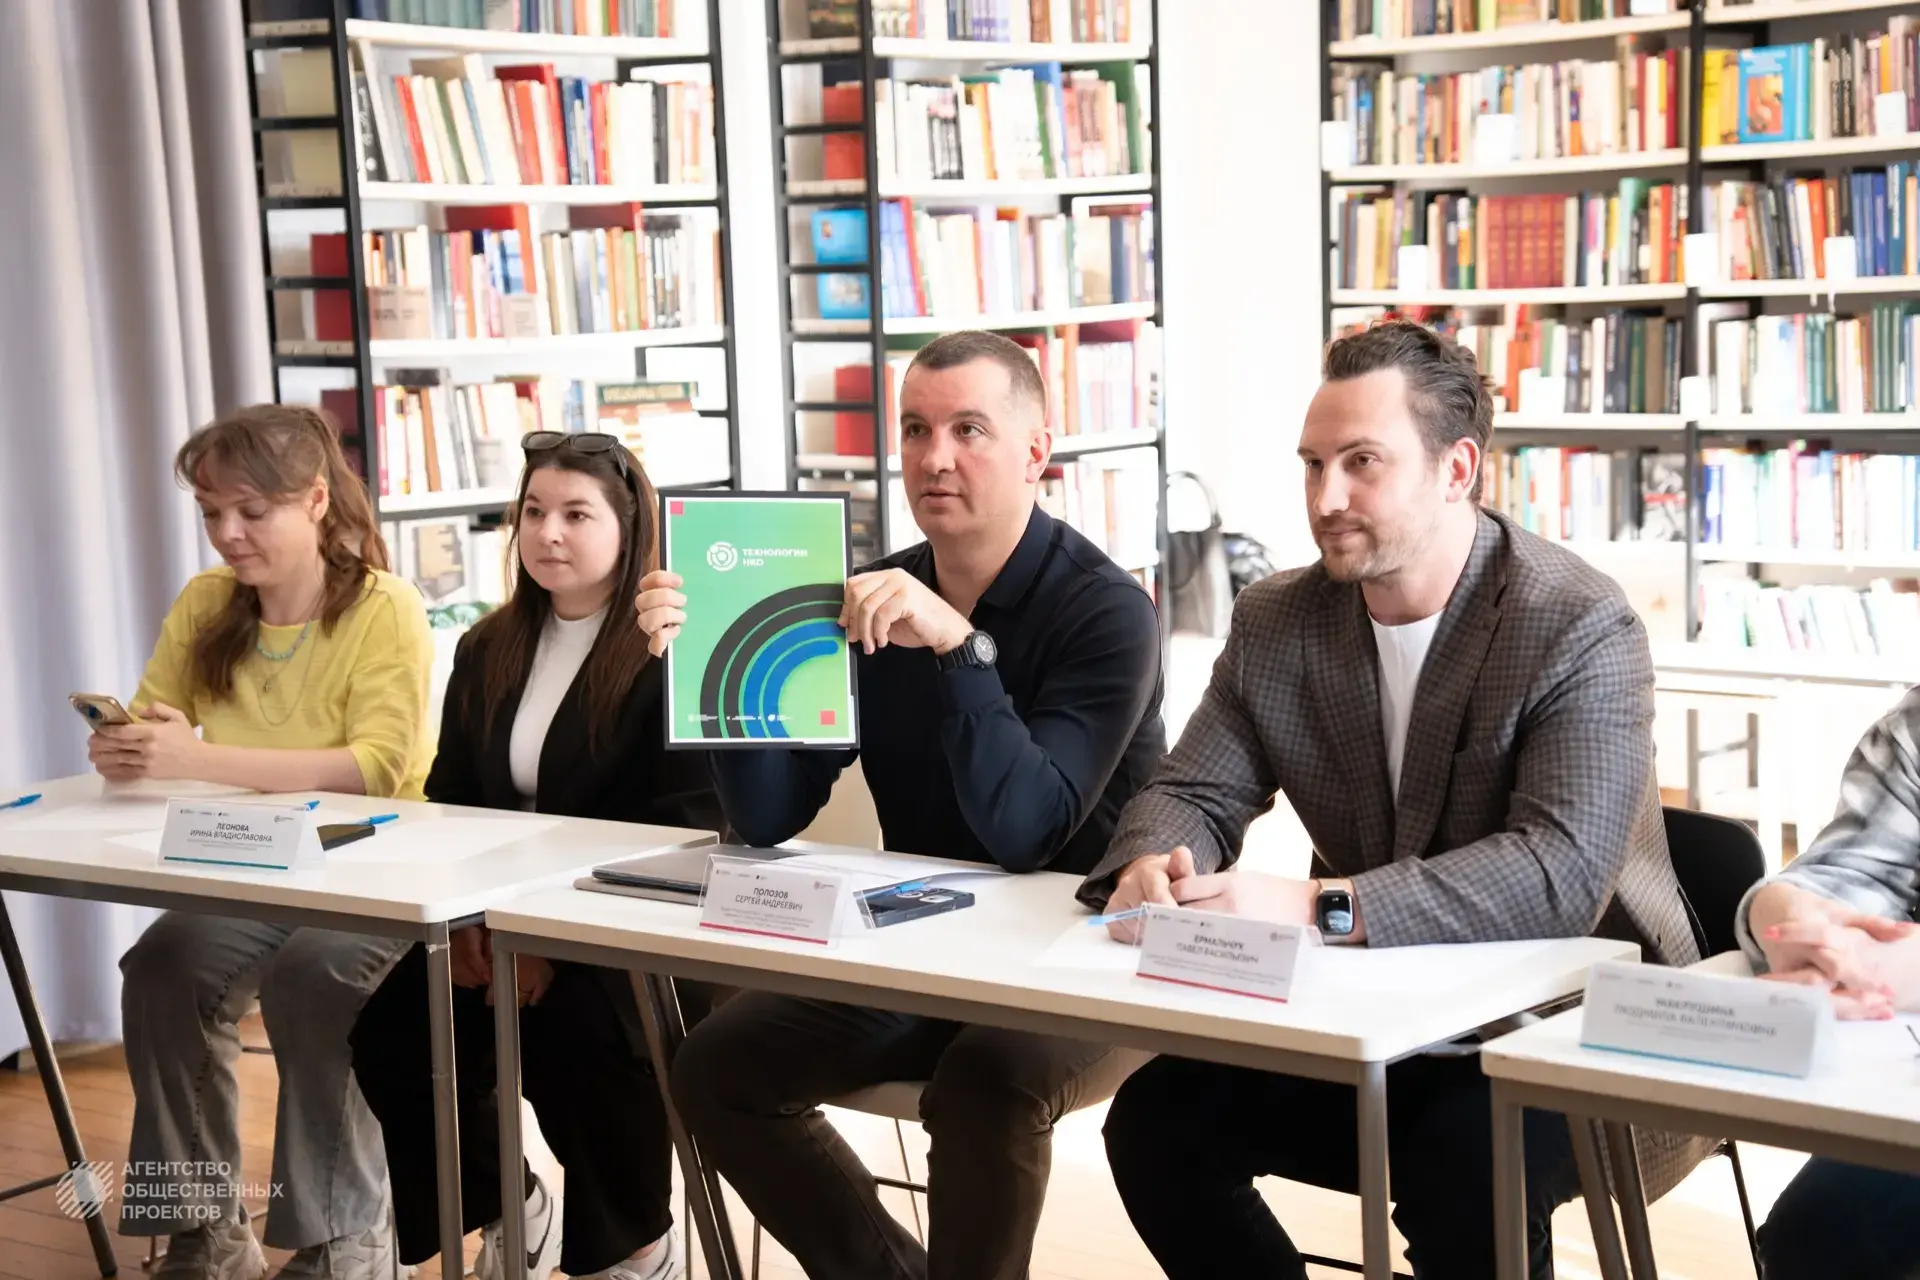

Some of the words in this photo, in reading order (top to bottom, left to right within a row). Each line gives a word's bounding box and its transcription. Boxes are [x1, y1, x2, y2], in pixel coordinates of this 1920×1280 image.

[742, 548, 808, 557] ТЕХНОЛОГИИ
[742, 558, 765, 567] НКО
[216, 822, 250, 832] ЛЕОНОВА
[190, 830, 212, 838] ИРИНА
[213, 831, 272, 842] ВЛАДИСЛАВОВНА
[753, 887, 788, 899] ПОЛОЗОВ
[735, 894, 761, 906] СЕРГЕЙ
[761, 899, 803, 911] АНДРЕЕВИЧ
